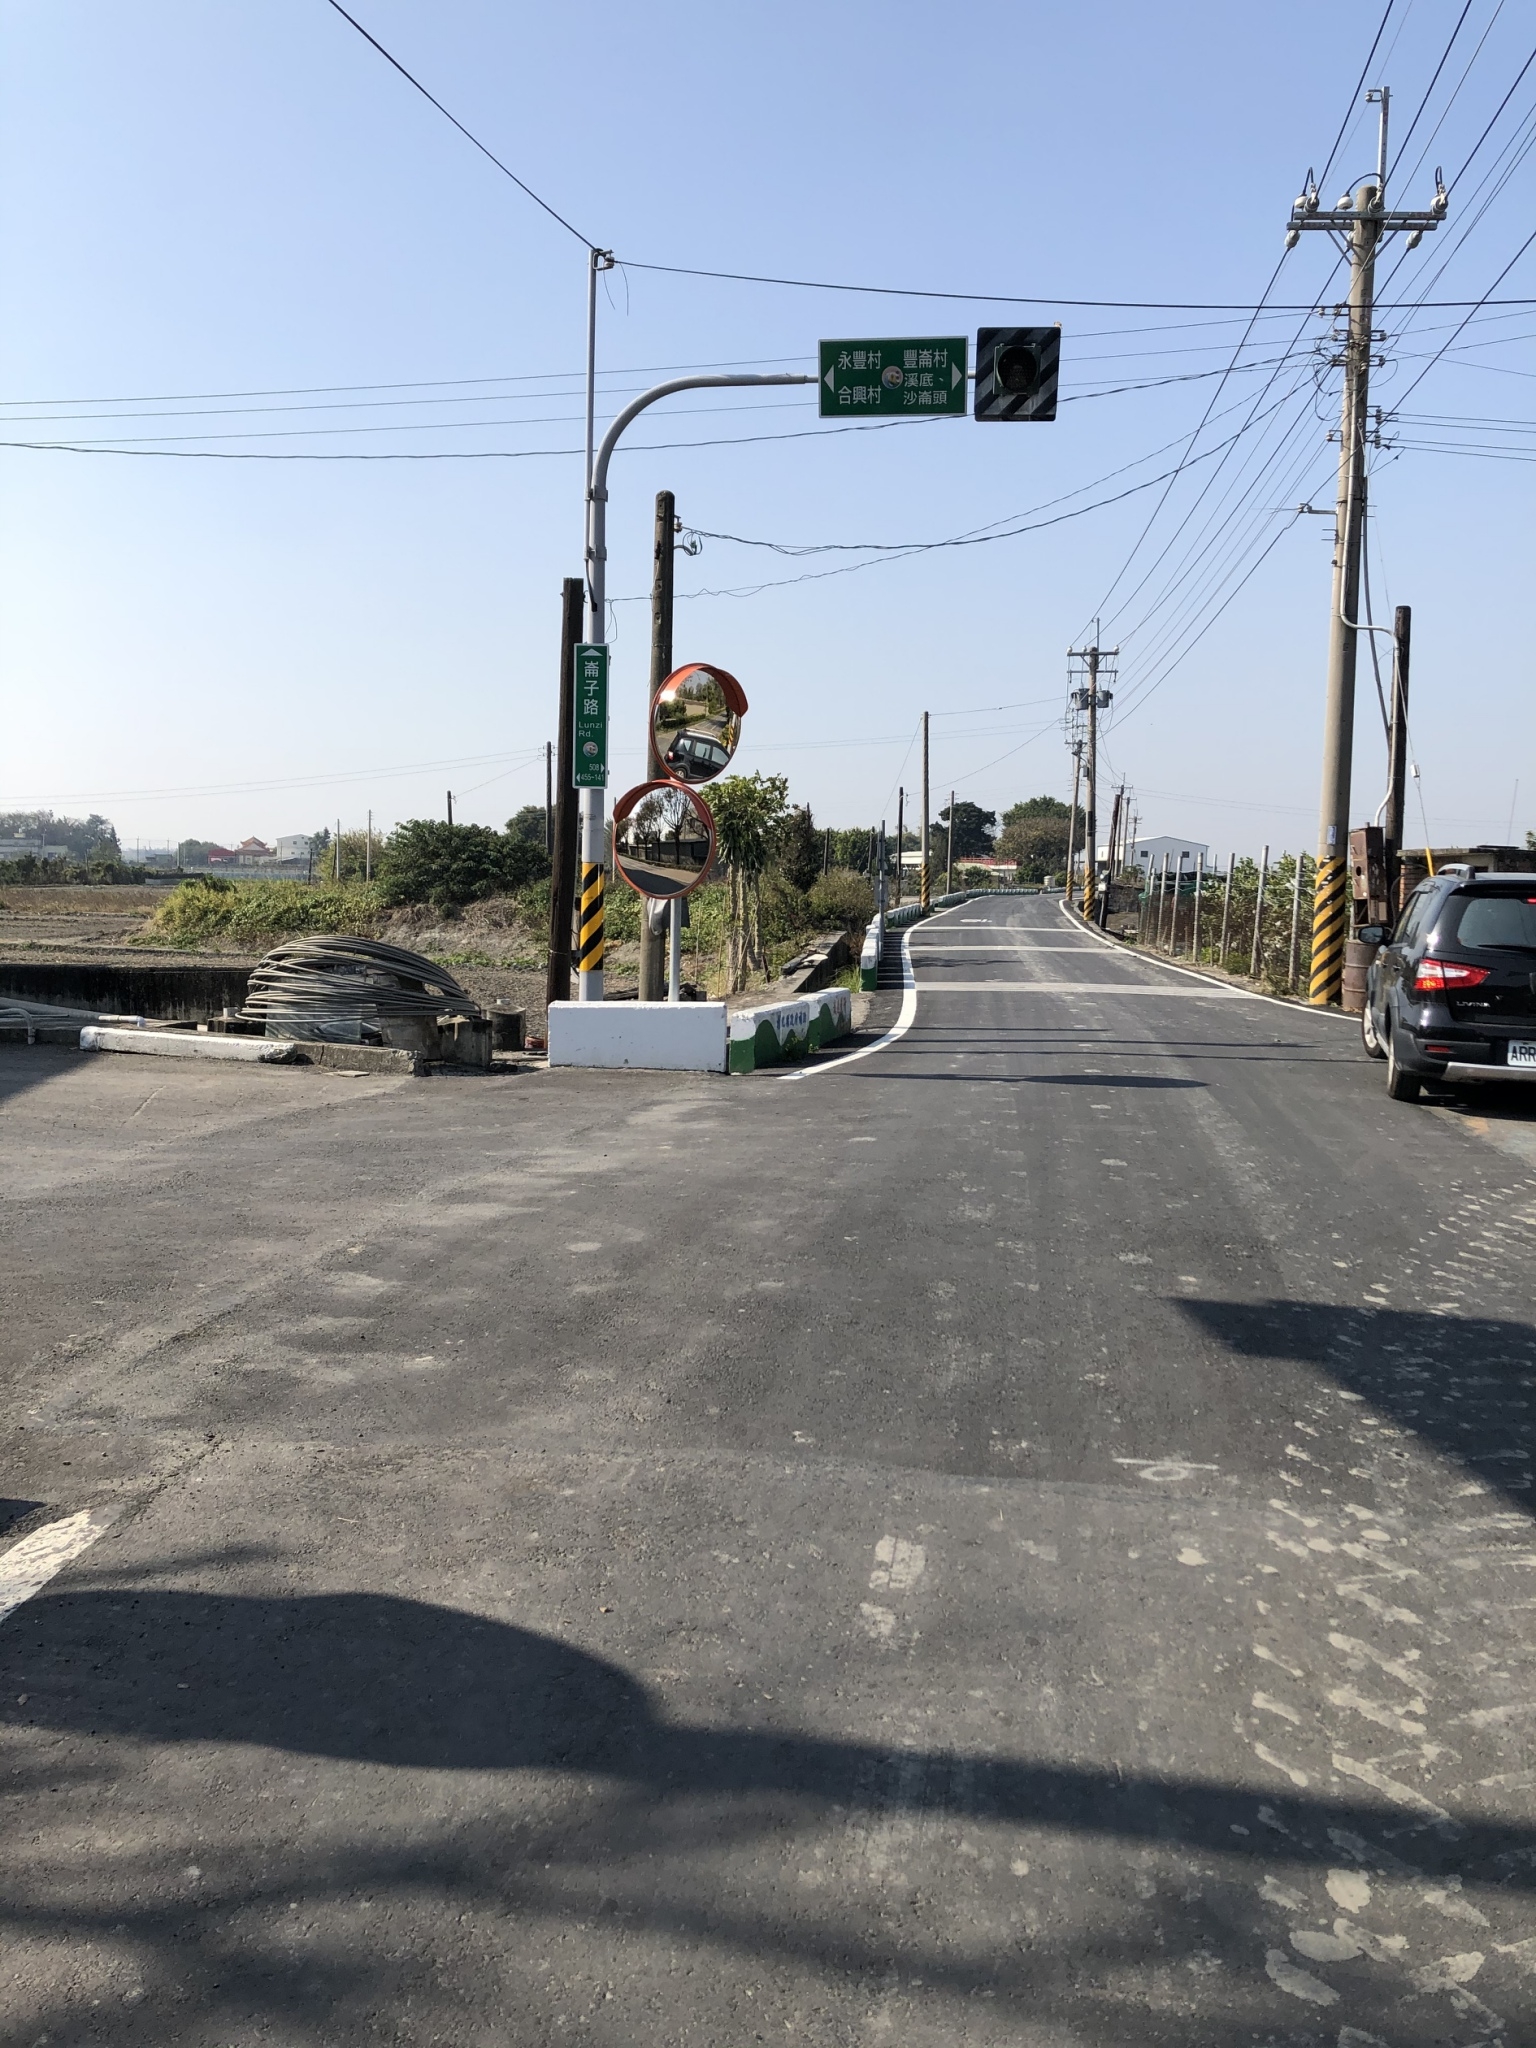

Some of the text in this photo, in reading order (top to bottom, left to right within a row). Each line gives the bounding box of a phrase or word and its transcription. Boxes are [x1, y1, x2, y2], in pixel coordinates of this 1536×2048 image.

[838, 350, 882, 370] 永豐村
[903, 348, 948, 369] 豐崙村
[838, 385, 882, 405] 合興村
[903, 390, 947, 406] 沙崙頭
[583, 660, 599, 715] 崙子路
[578, 730, 594, 738] Rd.
[579, 721, 603, 729] Lunzi
